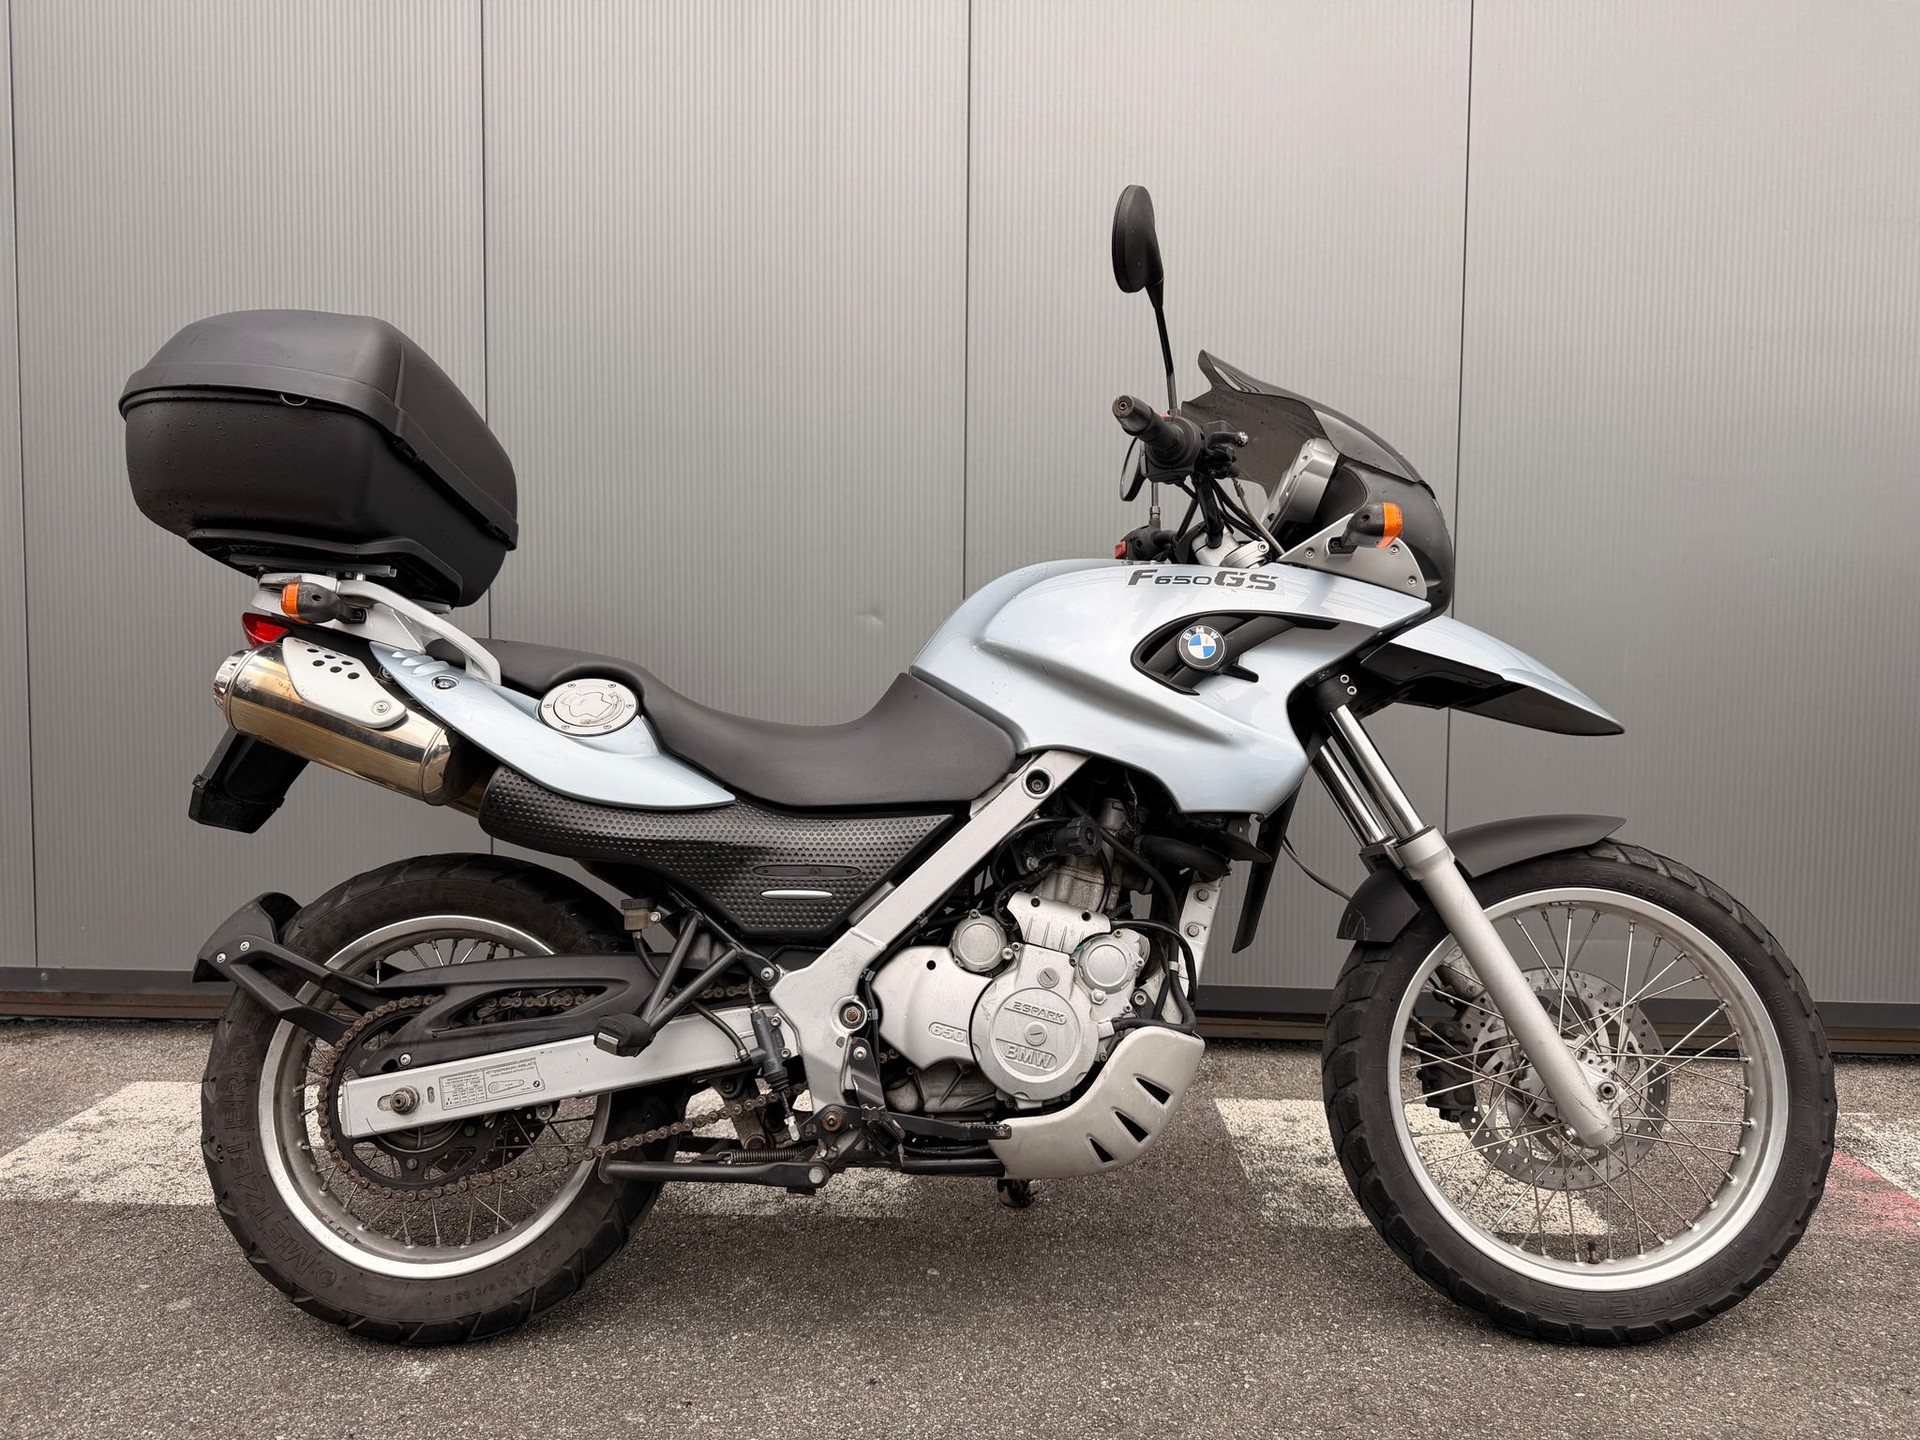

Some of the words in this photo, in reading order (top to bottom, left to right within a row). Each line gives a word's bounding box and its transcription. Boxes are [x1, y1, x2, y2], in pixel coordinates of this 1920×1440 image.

[1183, 627, 1219, 640] BMW
[1013, 1001, 1065, 1023] 2SPARK
[1004, 1044, 1053, 1069] BMW
[224, 1072, 315, 1275] METZELER
